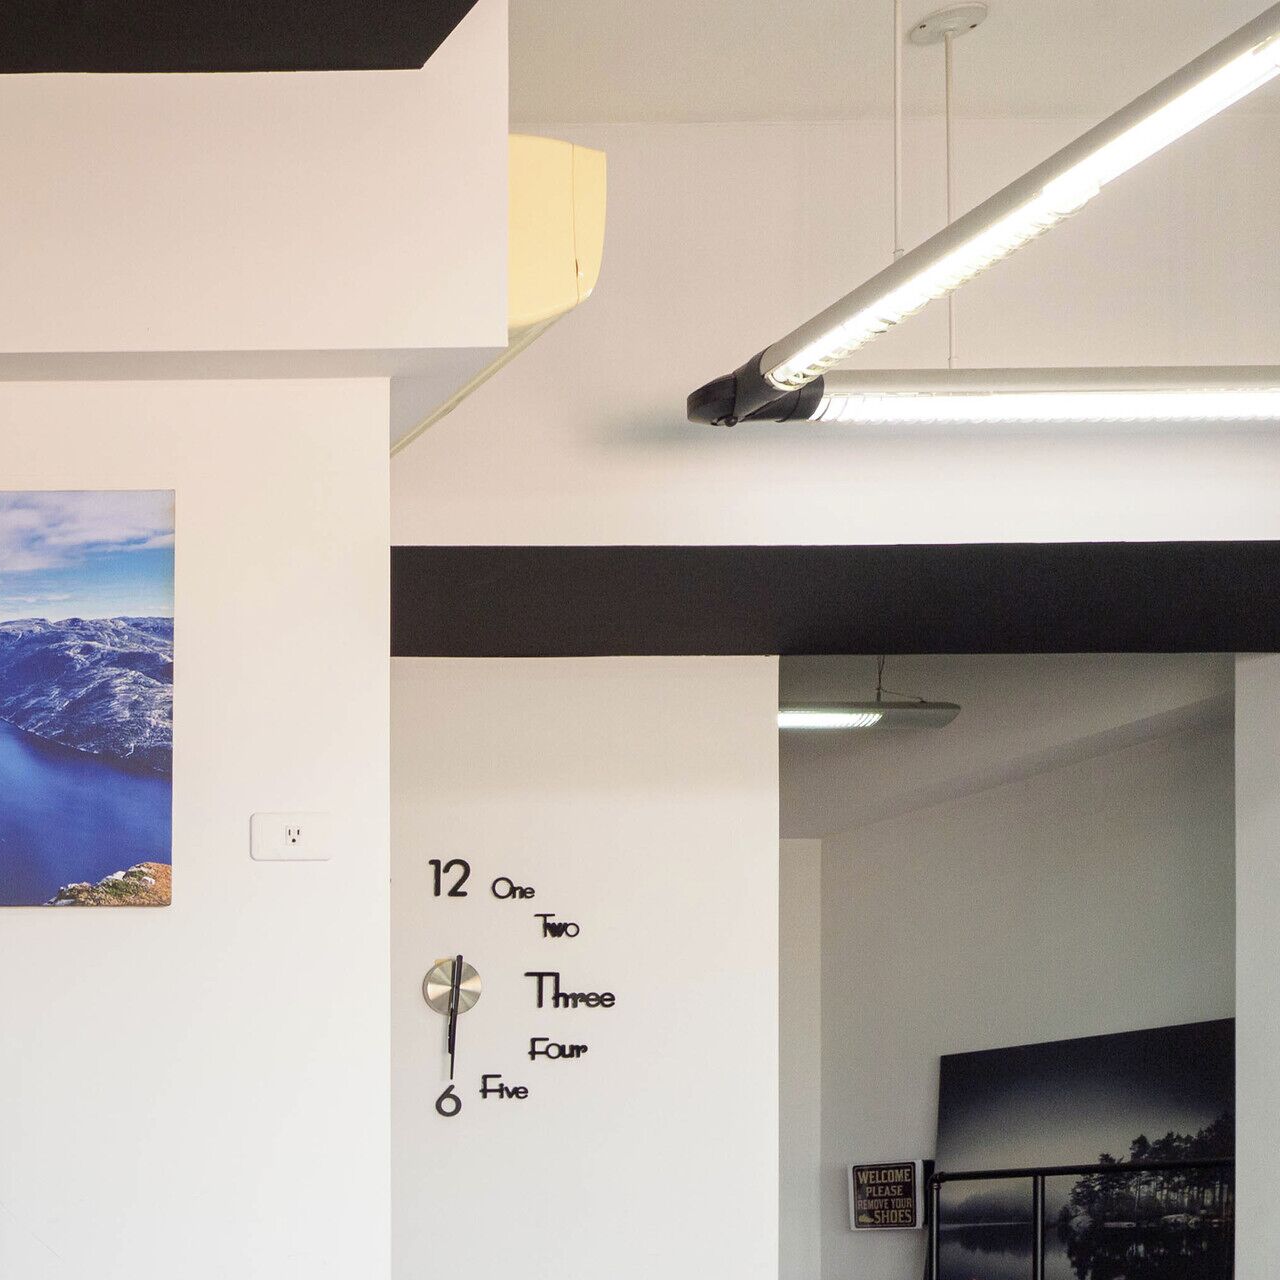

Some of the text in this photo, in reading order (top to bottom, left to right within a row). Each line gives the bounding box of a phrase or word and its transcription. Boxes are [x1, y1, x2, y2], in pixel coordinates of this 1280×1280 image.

[428, 858, 471, 897] 12
[491, 876, 536, 900] One
[533, 913, 580, 938] Two
[523, 971, 616, 1009] Three
[528, 1037, 589, 1061] Four
[479, 1074, 529, 1099] Five
[435, 1084, 463, 1118] 6
[857, 1168, 911, 1185] WELCOME
[866, 1185, 903, 1197] PLEASE
[857, 1197, 912, 1210] REMOVE YOUR
[874, 1209, 912, 1224] SHOES
